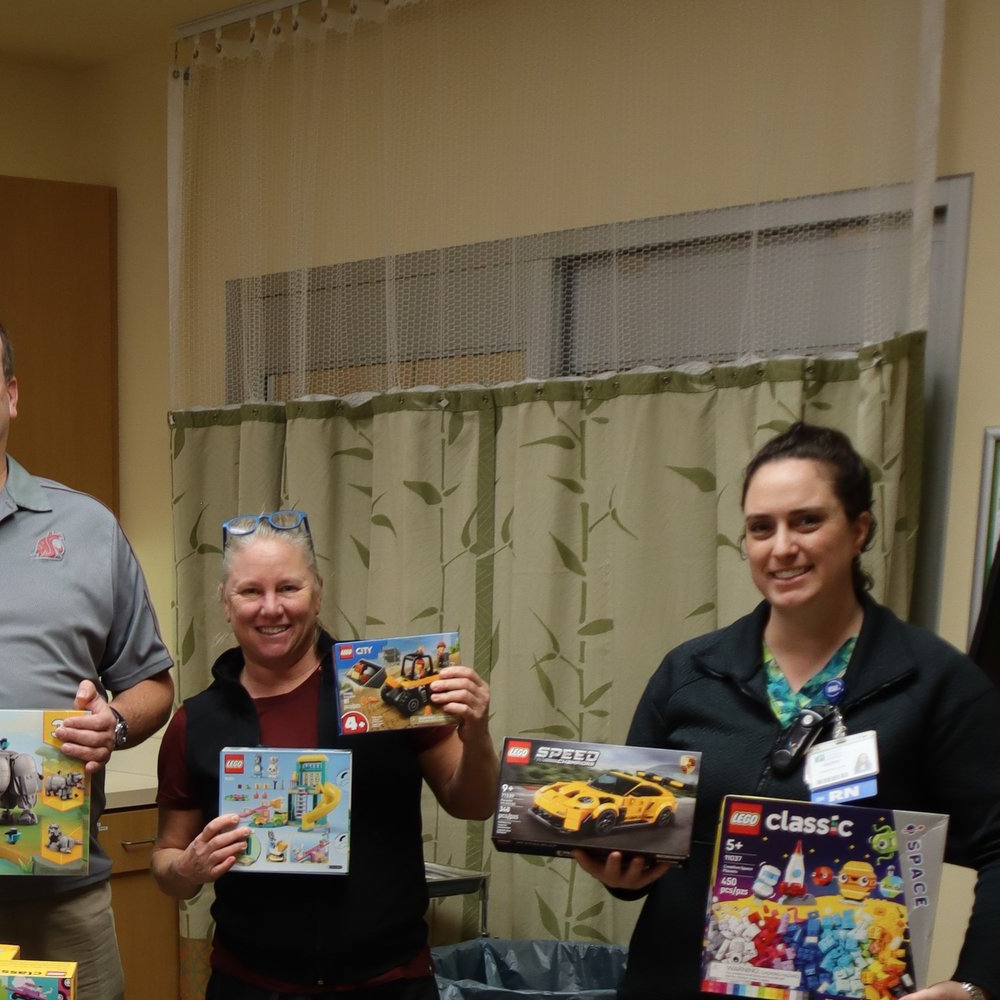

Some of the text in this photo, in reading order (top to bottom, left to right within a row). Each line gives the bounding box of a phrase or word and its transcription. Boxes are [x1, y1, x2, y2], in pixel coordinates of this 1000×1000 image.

[355, 646, 373, 655] CITY
[344, 716, 366, 731] 4+
[508, 747, 530, 758] LEGO
[535, 746, 600, 761] SPEED
[224, 760, 244, 769] LEGO
[502, 783, 514, 792] 9+
[828, 785, 860, 802] RN
[730, 811, 759, 826] LEGO
[765, 810, 855, 837] classic
[725, 838, 743, 852] 5+
[906, 840, 928, 908] SPACE
[721, 877, 738, 886] 450
[720, 886, 748, 895] pcs/pzs
